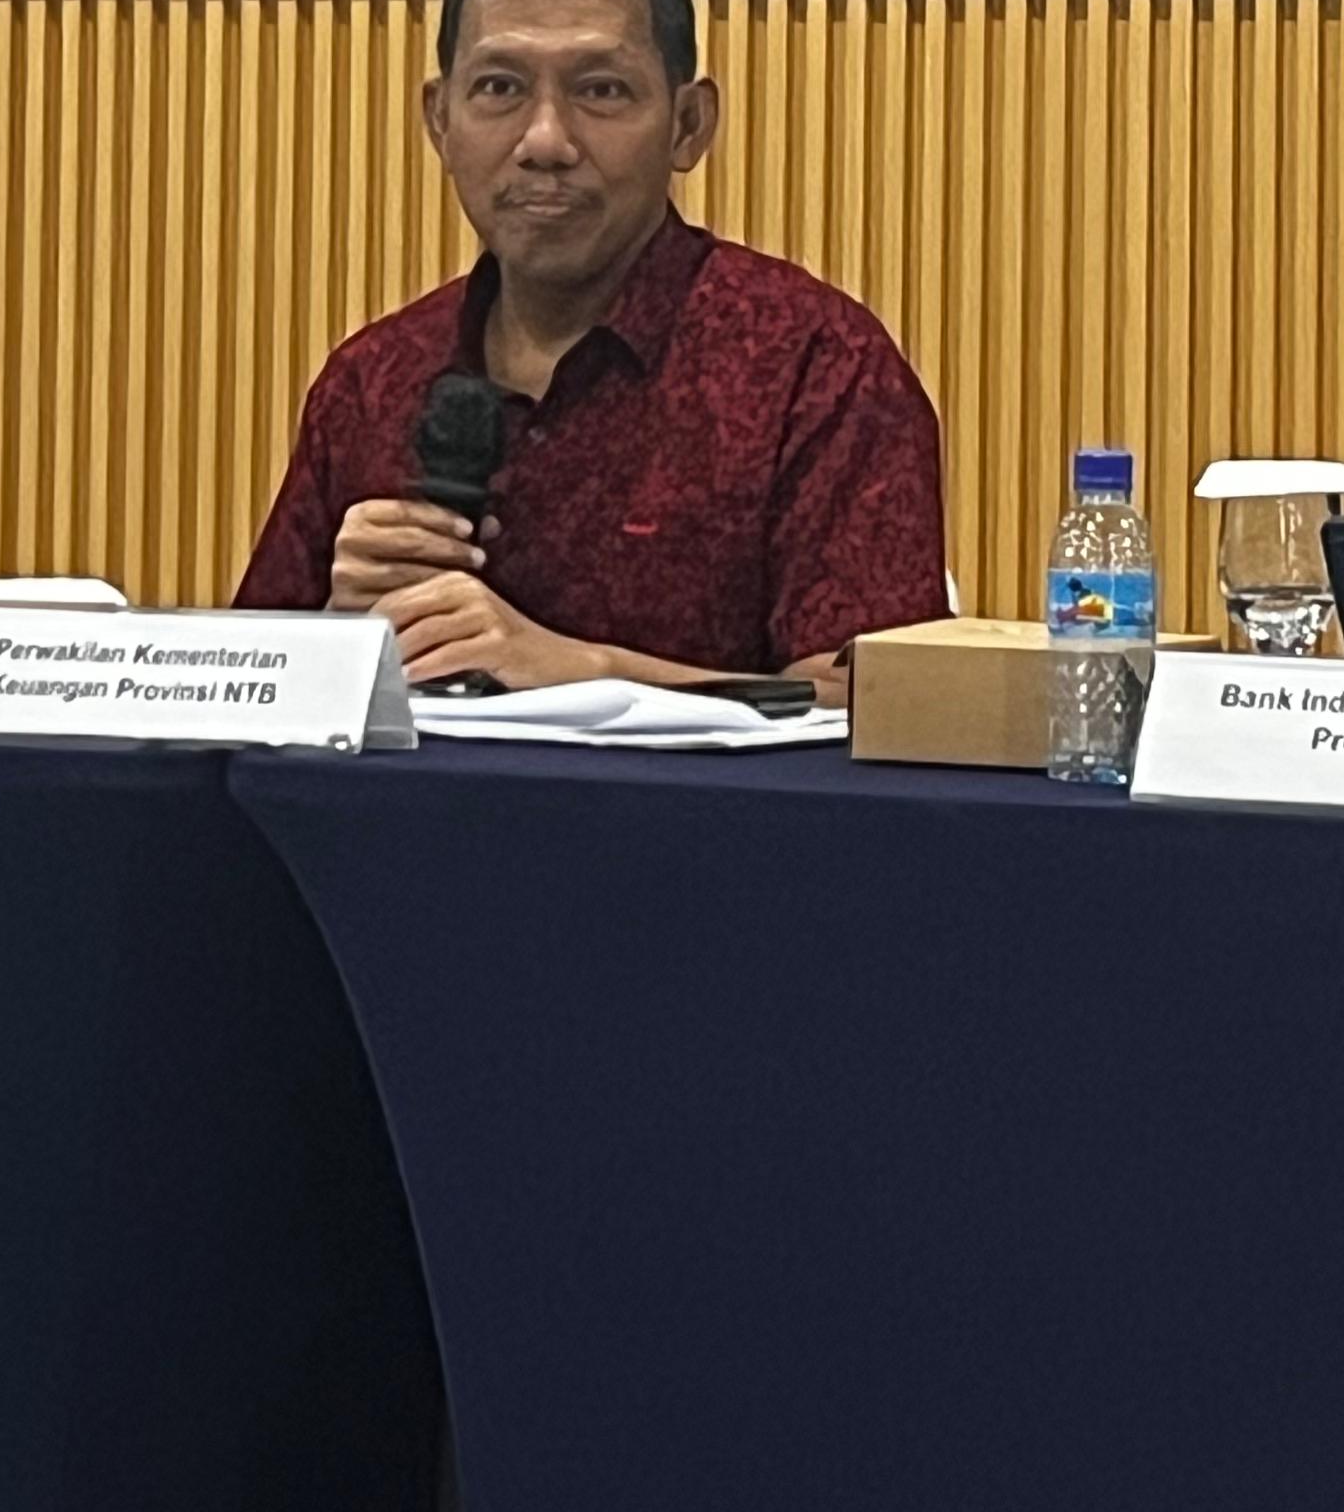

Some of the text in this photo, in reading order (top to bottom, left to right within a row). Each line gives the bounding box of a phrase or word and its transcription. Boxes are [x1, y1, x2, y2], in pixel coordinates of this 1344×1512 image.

[133, 644, 288, 669] Kementerian
[116, 678, 217, 702] Provinsi
[224, 682, 276, 704] NTB
[1221, 684, 1292, 710] Bank
